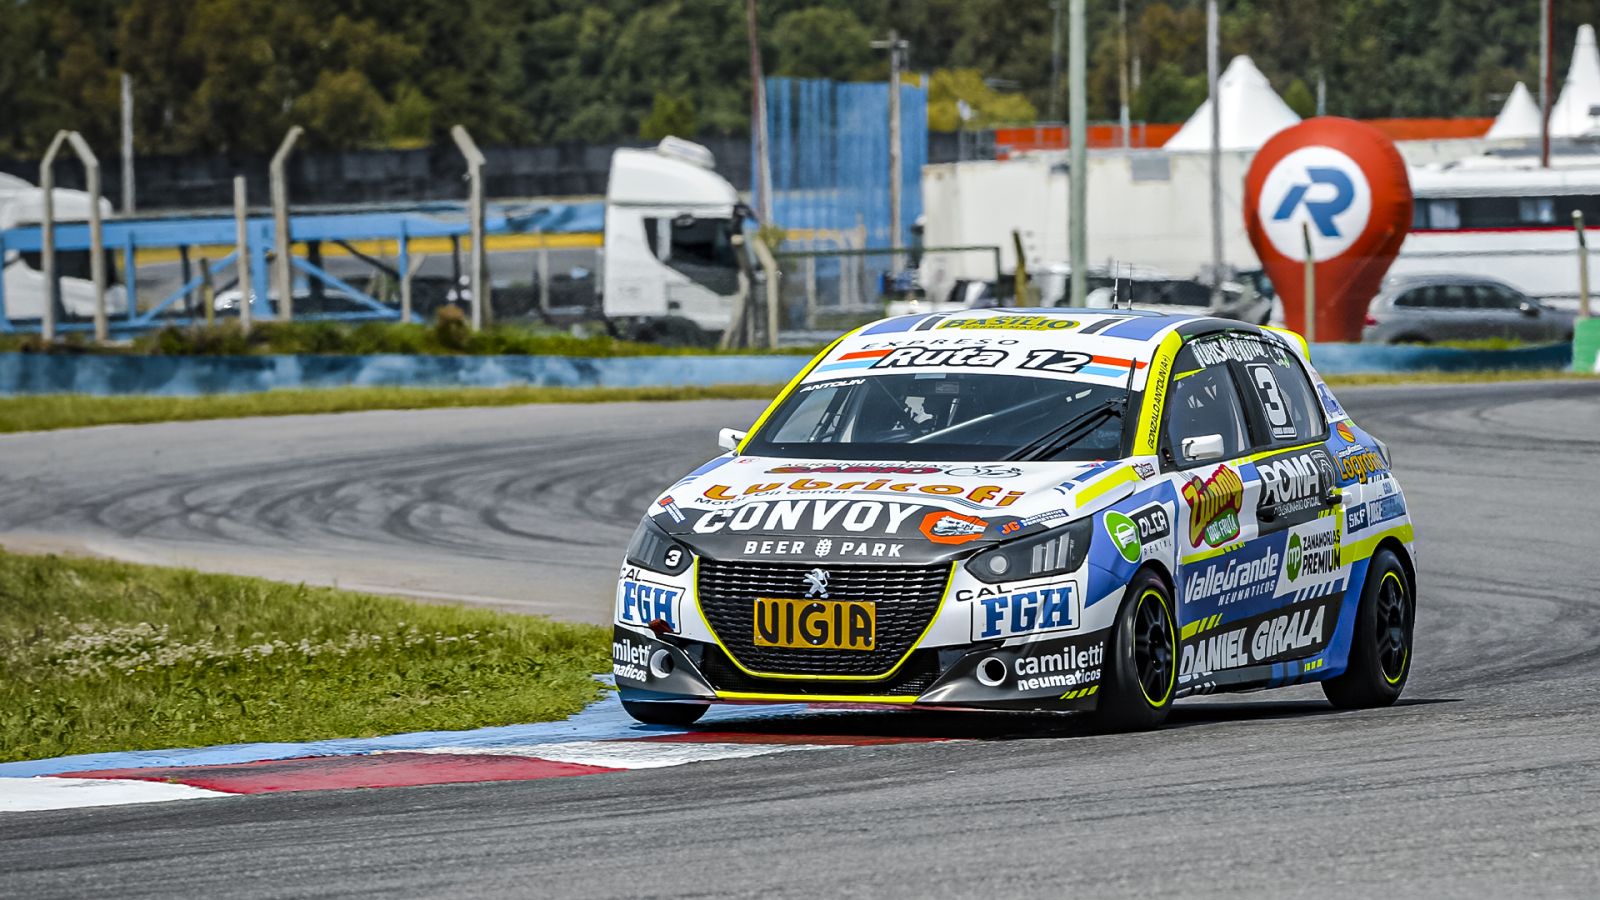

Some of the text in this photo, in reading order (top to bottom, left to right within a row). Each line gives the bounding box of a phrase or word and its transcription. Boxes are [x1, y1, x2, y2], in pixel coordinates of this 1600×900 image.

[944, 319, 1075, 329] BASILIO
[862, 339, 1020, 350] EXPRESO
[871, 346, 1092, 373] Ruta 12
[800, 378, 866, 393] ANTOLIN
[1255, 367, 1287, 426] 3
[1148, 404, 1161, 449] GONZALO
[703, 479, 1026, 506] Lubricofi
[1256, 454, 1320, 505] ROMA
[692, 501, 924, 534] CONVOY
[1348, 508, 1366, 529] SKF
[665, 549, 682, 567] 3
[743, 541, 905, 558] BEER PARK
[1302, 548, 1341, 577] PREMIUM
[1185, 546, 1279, 605] ValleGrande
[622, 581, 678, 630] FGH
[956, 585, 1011, 602] CAL
[1218, 580, 1276, 607] NEUMATICOS
[756, 601, 873, 647] VIGIA
[981, 586, 1073, 638] FGH
[1179, 605, 1326, 676] DANIEL GIRALA
[1015, 641, 1104, 675] camiletti
[1018, 668, 1102, 691] neumaticos
